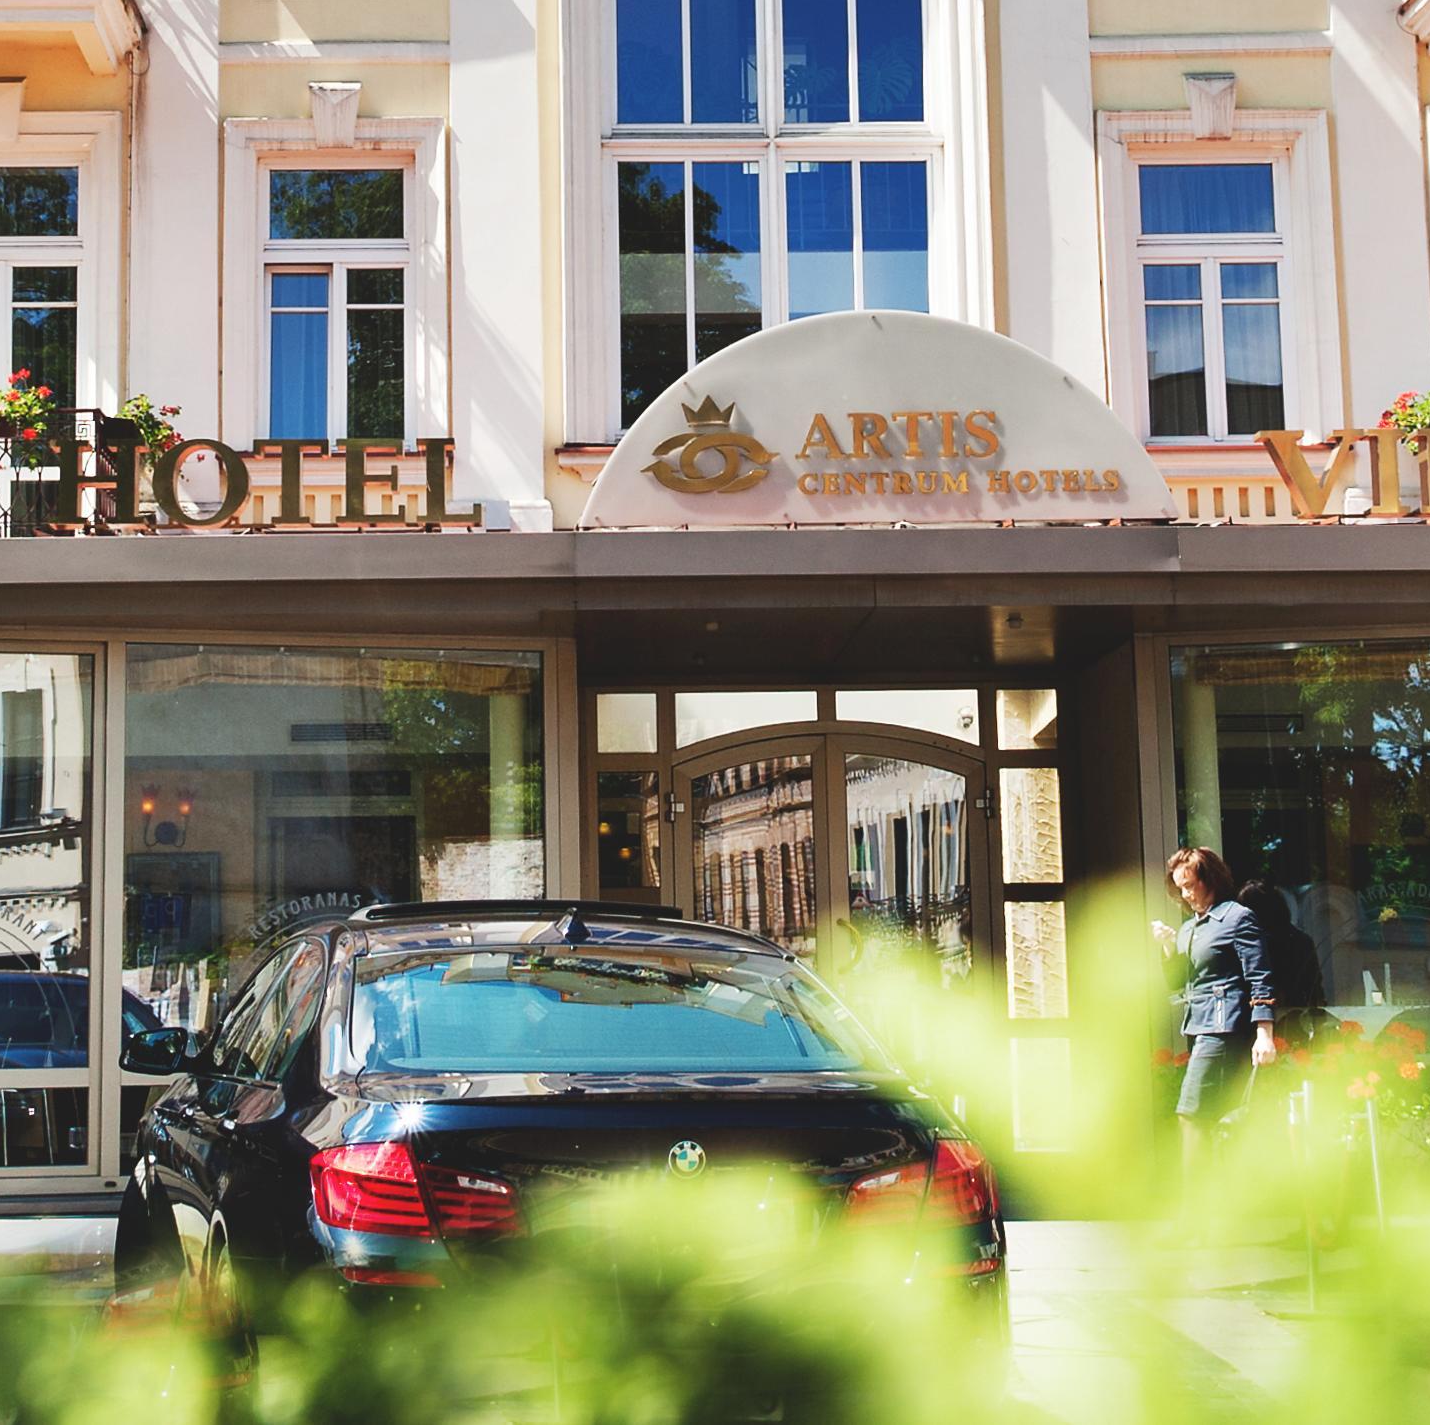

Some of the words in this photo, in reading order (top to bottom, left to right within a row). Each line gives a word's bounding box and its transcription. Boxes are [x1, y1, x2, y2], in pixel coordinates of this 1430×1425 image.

[795, 410, 1000, 459] ARTIS
[50, 437, 483, 527] HOTEL
[797, 470, 969, 496] CENTRUM
[987, 470, 1120, 493] HOTELS
[247, 892, 362, 940] RESTORANAS
